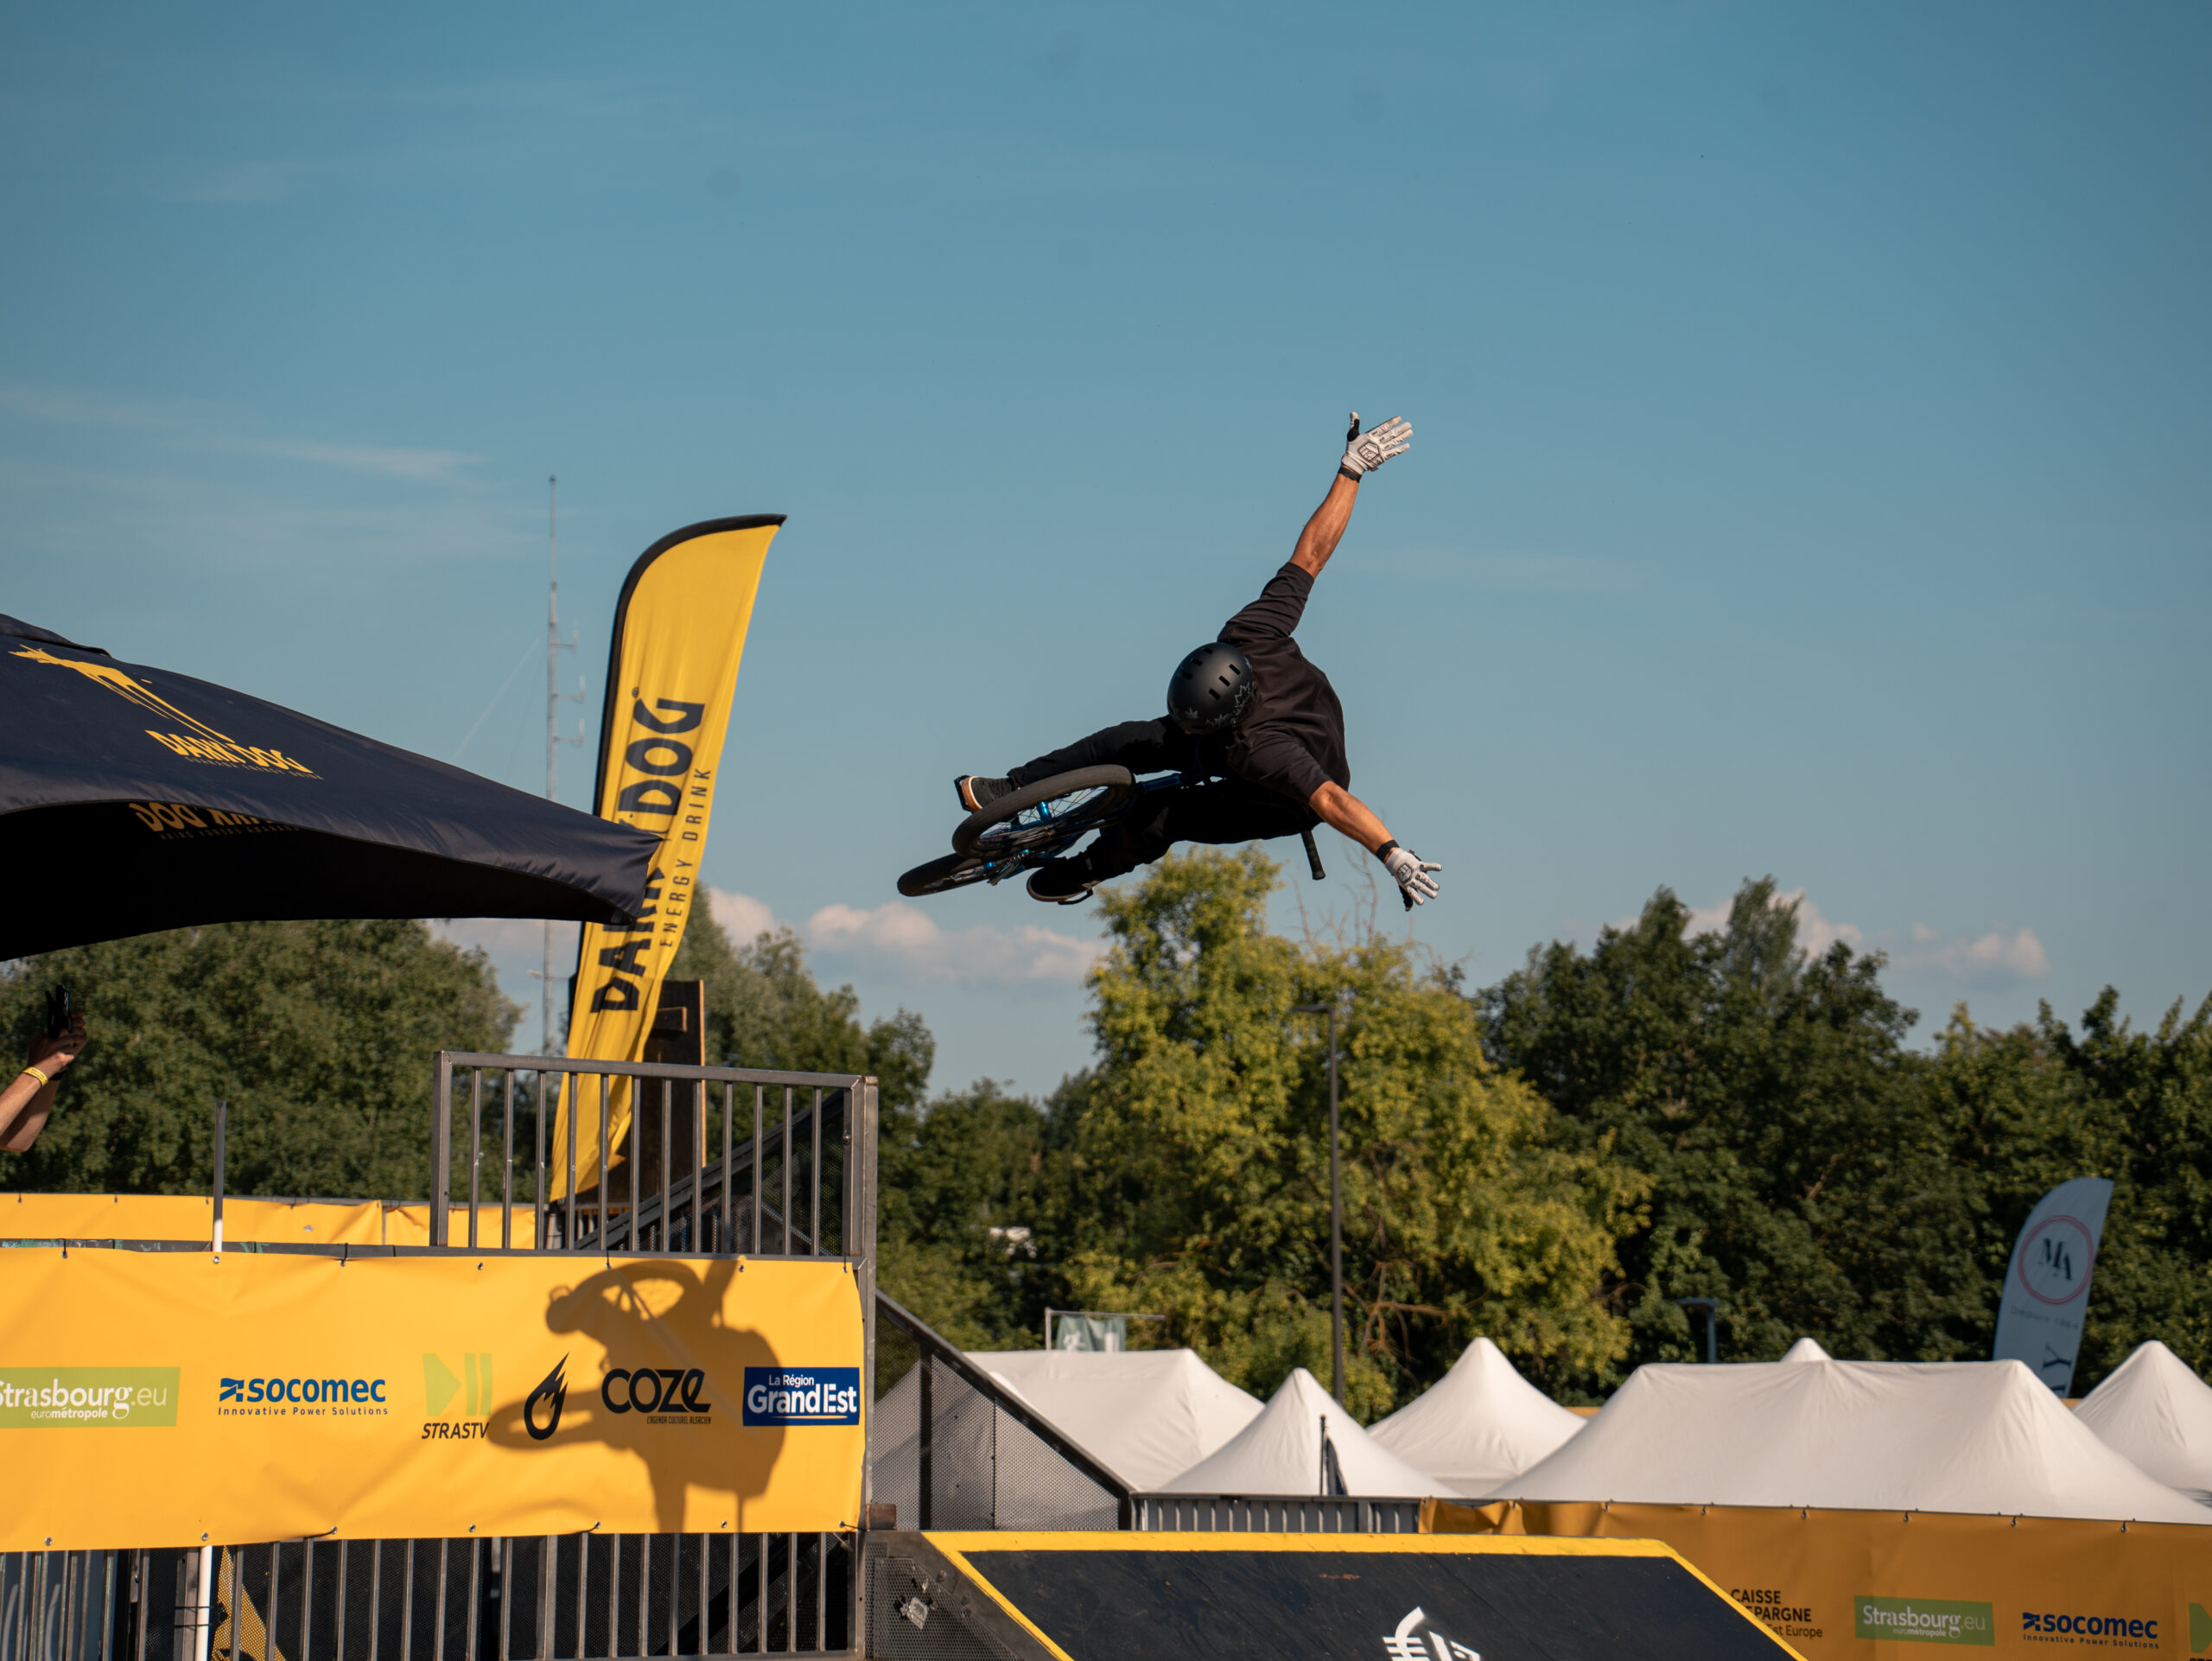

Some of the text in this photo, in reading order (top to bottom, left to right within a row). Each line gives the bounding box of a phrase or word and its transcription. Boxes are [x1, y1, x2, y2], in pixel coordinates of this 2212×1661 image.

[145, 730, 246, 764] DARK
[225, 743, 315, 773] DOG
[617, 697, 706, 815] DOG
[659, 768, 711, 948] ENERGY DRINK
[768, 1374, 815, 1388] La Région
[246, 1378, 386, 1403] socomec
[31, 1406, 109, 1421] eurométropole
[218, 1407, 388, 1416] Innovative Power Solutions
[422, 1422, 490, 1440] STRASTV
[1731, 1588, 1782, 1605] CAISSE
[1863, 1604, 1986, 1639] Strasbourg.eu
[2043, 1613, 2158, 1639] socomec
[1785, 1625, 1823, 1640] Europe
[2023, 1633, 2159, 1650] Innovative Power Solutions
